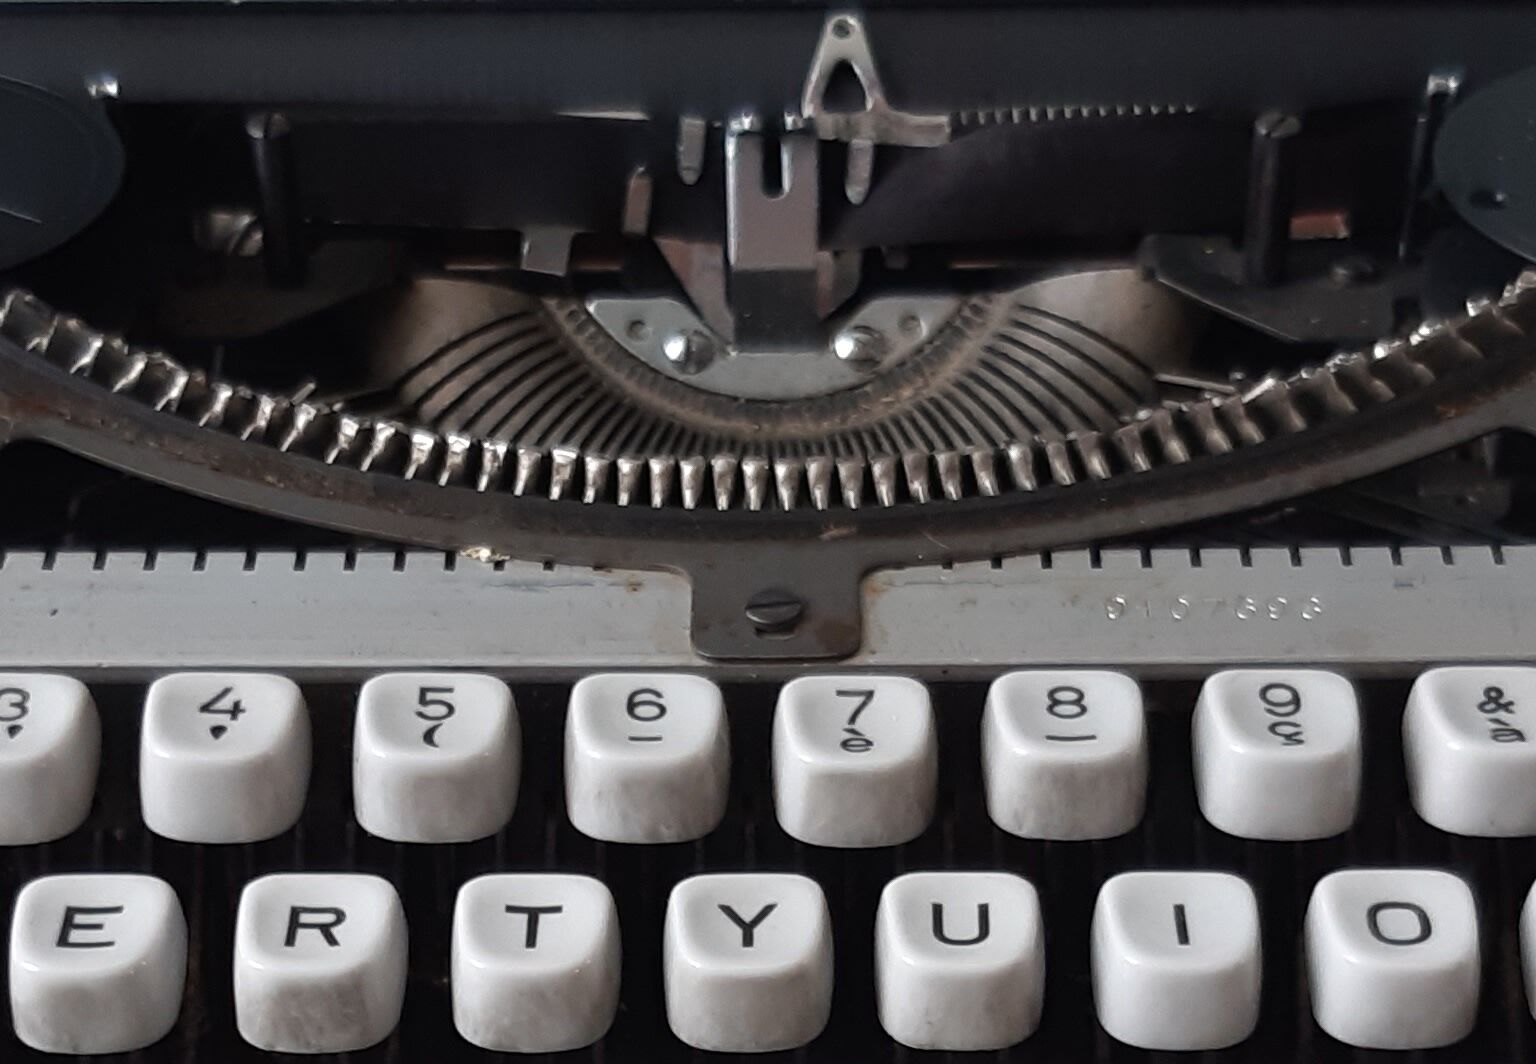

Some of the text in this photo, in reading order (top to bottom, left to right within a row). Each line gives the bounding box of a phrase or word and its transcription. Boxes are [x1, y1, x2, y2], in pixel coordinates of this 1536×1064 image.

[199, 687, 245, 720] 4
[415, 687, 456, 722] 5
[627, 688, 666, 721] 6
[835, 690, 875, 726] 7
[1046, 686, 1087, 719] 8
[1259, 683, 1301, 717] 9
[1477, 687, 1514, 713] &
[840, 728, 874, 753] è
[56, 906, 123, 948] E
[284, 906, 346, 947] R
[505, 905, 562, 948] T
[718, 904, 777, 947] Y
[932, 903, 989, 945] U
[1174, 904, 1189, 945] I
[1367, 902, 1432, 945] O
